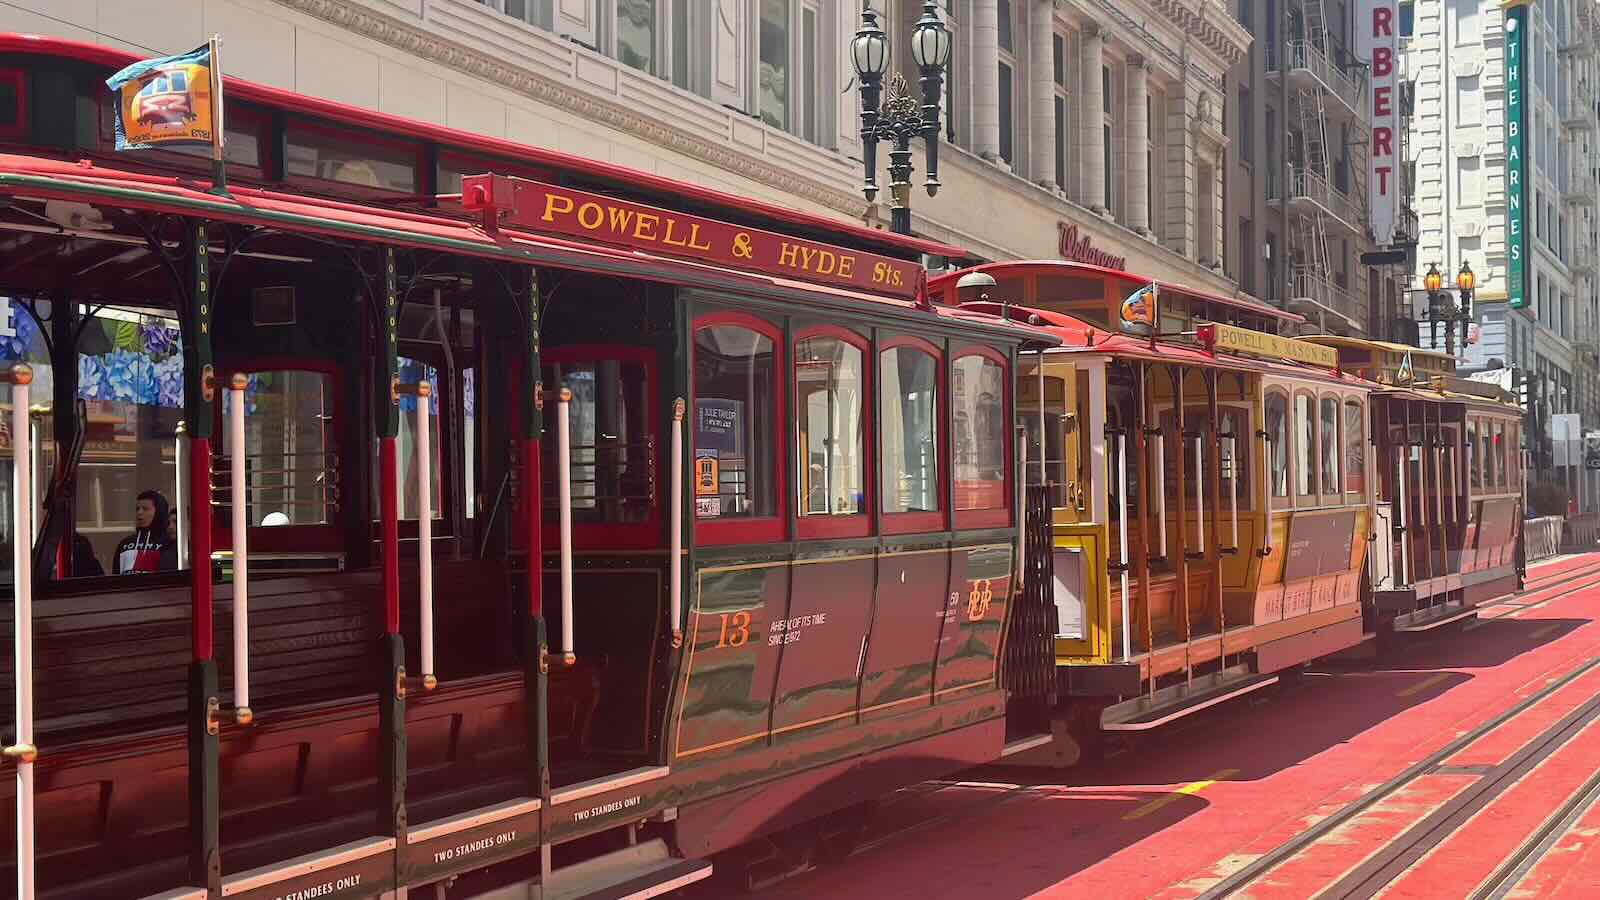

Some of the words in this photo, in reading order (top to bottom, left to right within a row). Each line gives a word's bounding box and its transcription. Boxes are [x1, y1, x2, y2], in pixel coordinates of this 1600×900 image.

[1508, 42, 1518, 105] THE
[1508, 121, 1521, 260] BARNES
[541, 193, 711, 251] POWELL
[731, 232, 753, 259] &
[778, 242, 855, 280] HYDE
[872, 261, 904, 287] Sts.
[198, 225, 208, 292] HOLD
[200, 304, 208, 335] ON
[1221, 328, 1264, 350] POWELL
[1285, 340, 1318, 361] MASON
[715, 611, 752, 649] 13
[573, 809, 590, 822] TWO
[591, 800, 622, 818] STANDEES
[624, 795, 642, 808] ONLY
[433, 850, 454, 864] TWO
[455, 837, 494, 859] STANDEES
[496, 831, 517, 845] ONLY
[336, 874, 361, 890] ONLY
